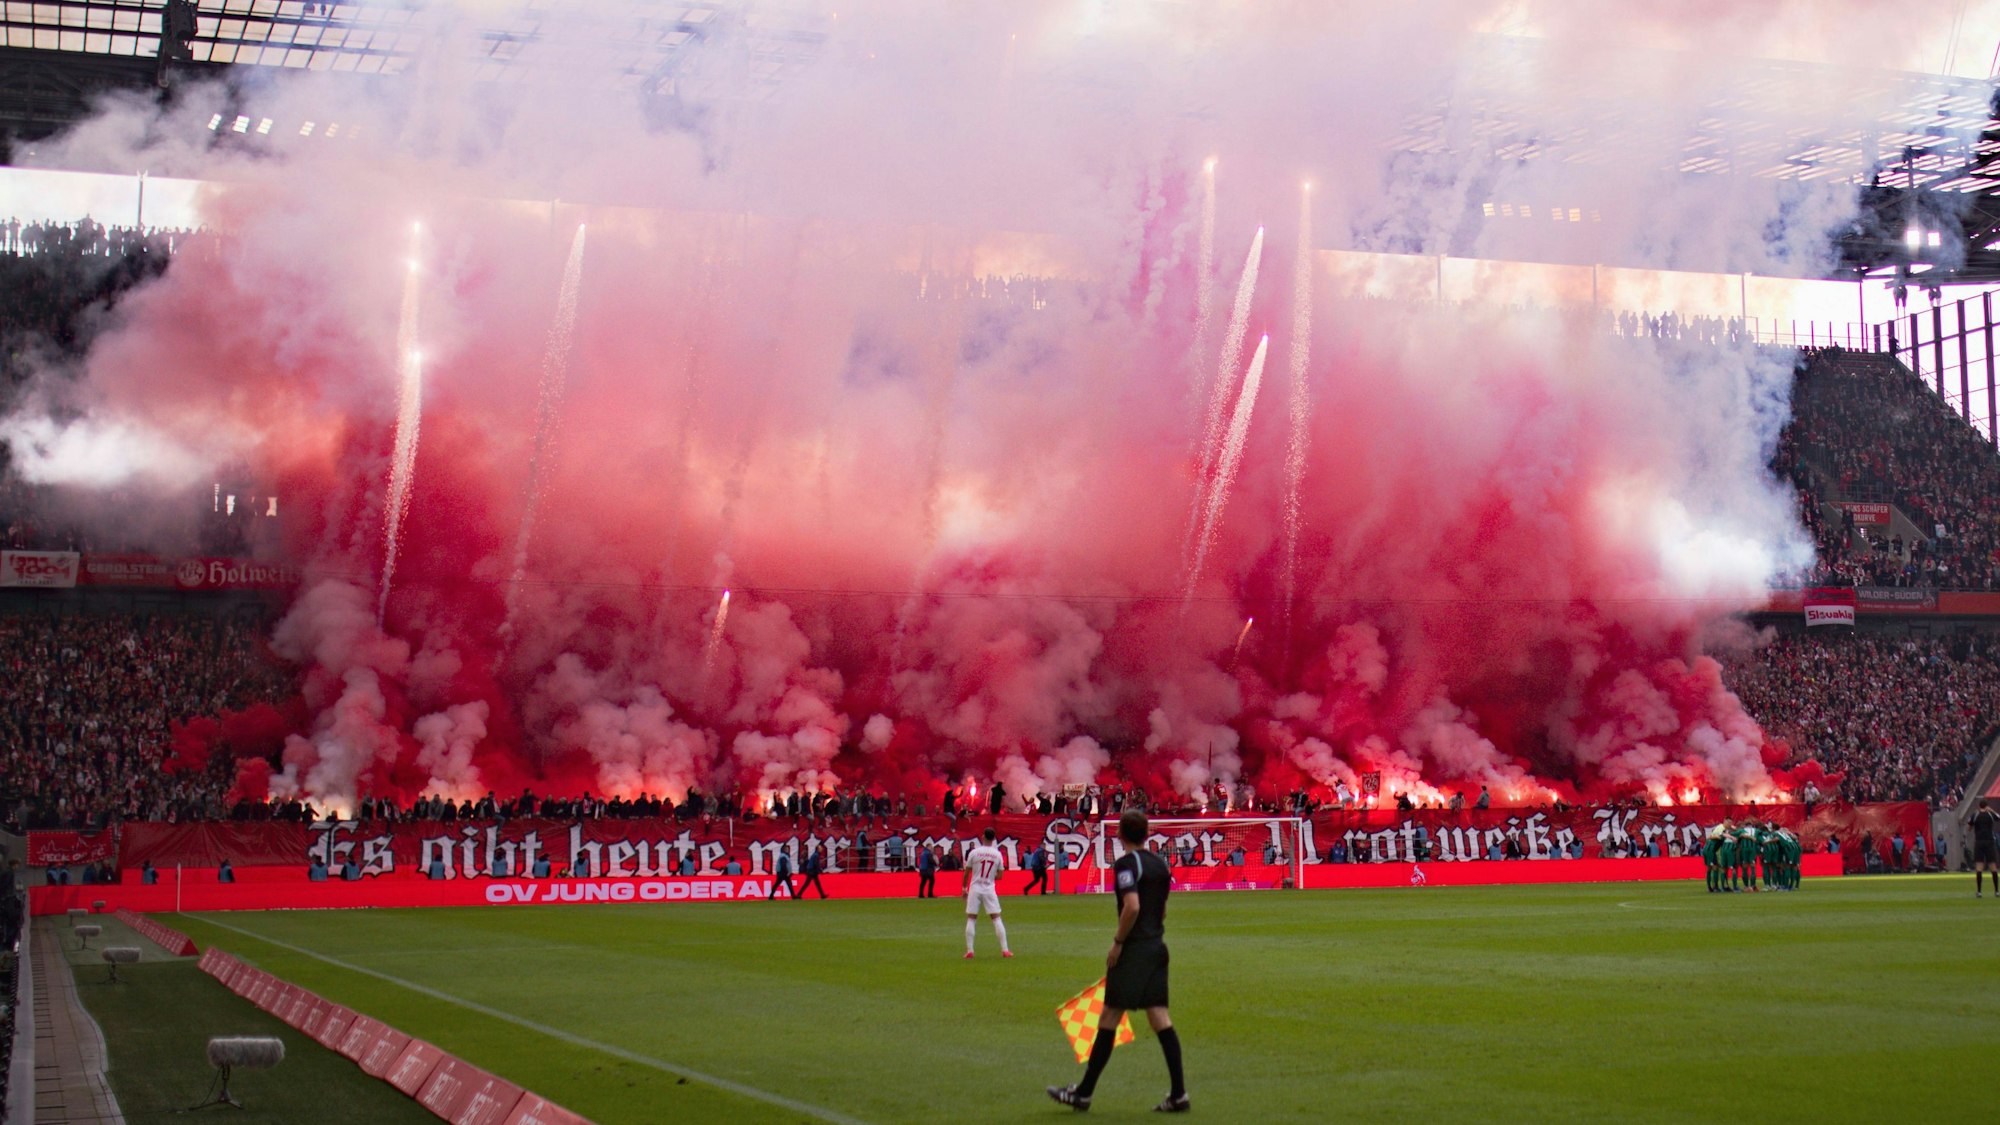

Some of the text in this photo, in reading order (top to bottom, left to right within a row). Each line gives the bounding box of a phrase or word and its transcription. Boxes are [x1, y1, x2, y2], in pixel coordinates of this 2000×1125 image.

[1845, 503, 1889, 513] HNS SCHÄFER
[1808, 610, 1853, 620] Slovakia
[308, 820, 394, 878] Es
[568, 823, 725, 878] heute
[1342, 819, 1416, 864] rot
[1436, 812, 1576, 862] weiße
[980, 859, 995, 879] 17
[486, 879, 797, 903] OV JUNG ODER ALT
